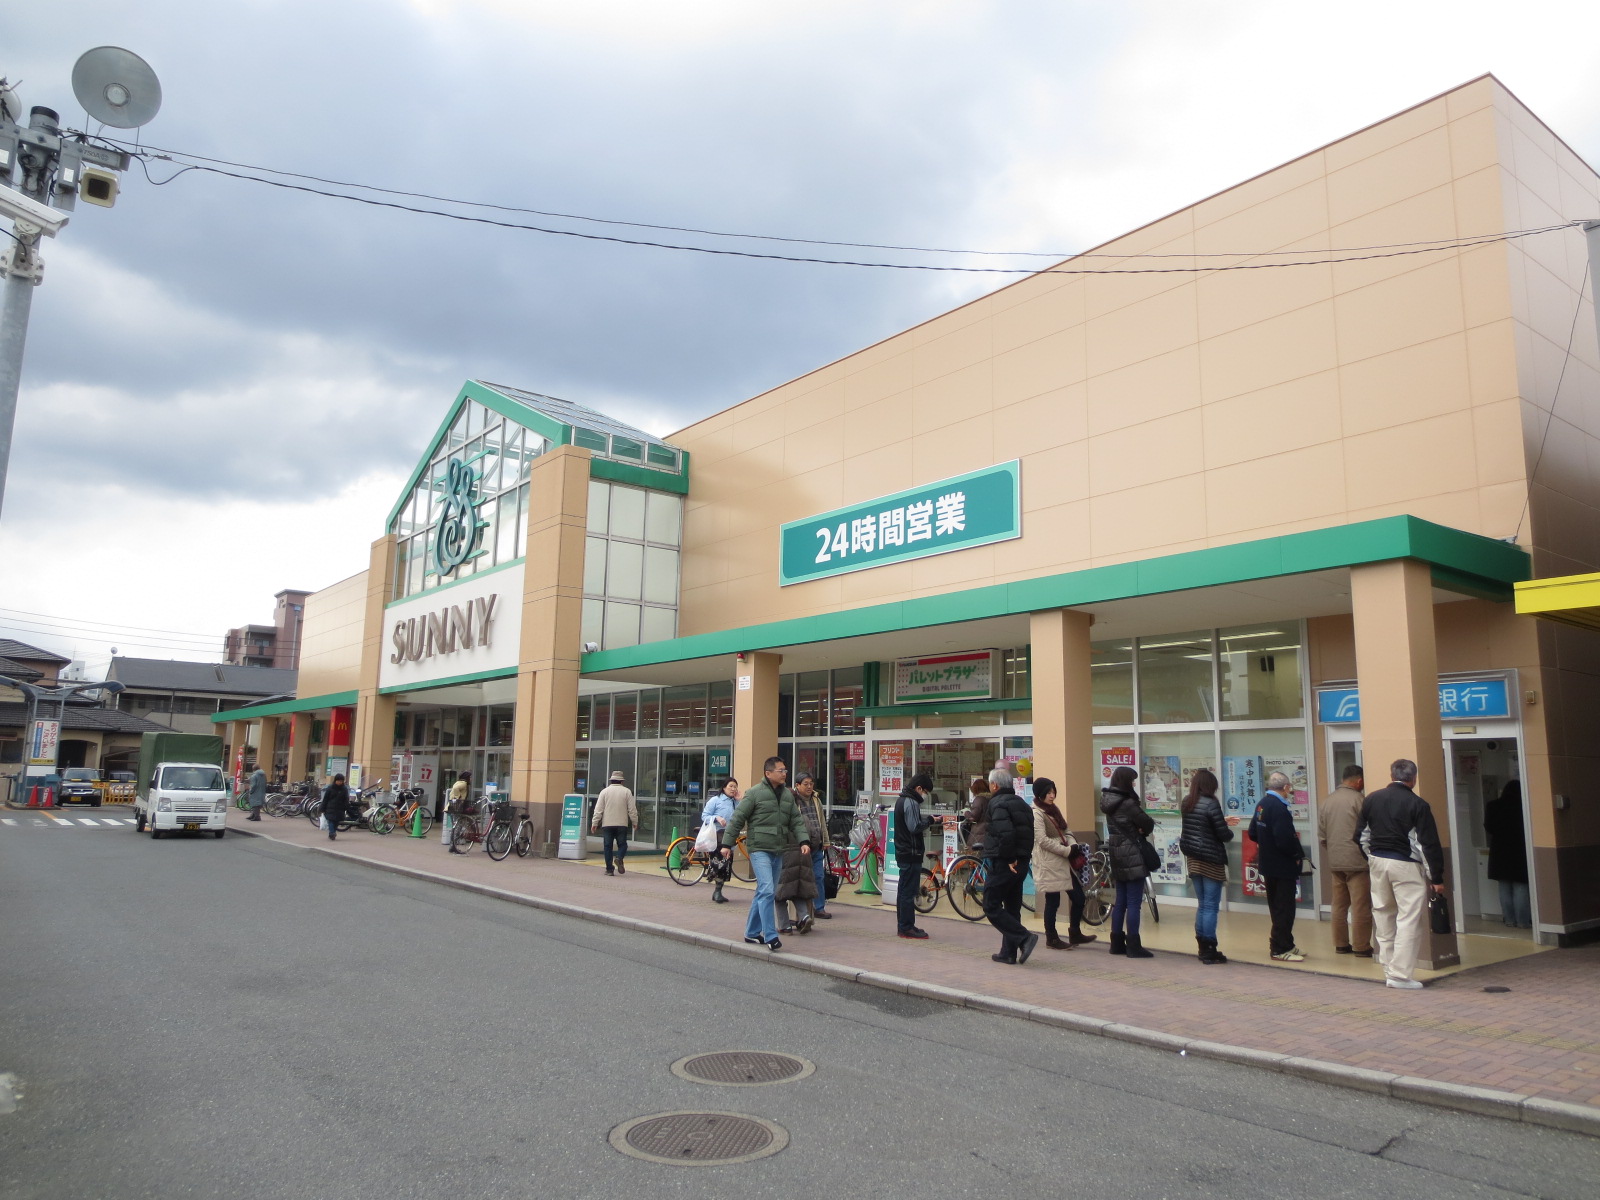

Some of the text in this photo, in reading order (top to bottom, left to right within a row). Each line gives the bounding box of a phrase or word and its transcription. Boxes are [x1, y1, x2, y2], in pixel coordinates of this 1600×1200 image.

[814, 491, 966, 564] 24時間営業
[391, 593, 498, 664] SUNNY
[908, 665, 977, 684] パレットプラザ
[1106, 754, 1133, 764] SALE!
[881, 777, 901, 791] 半額
